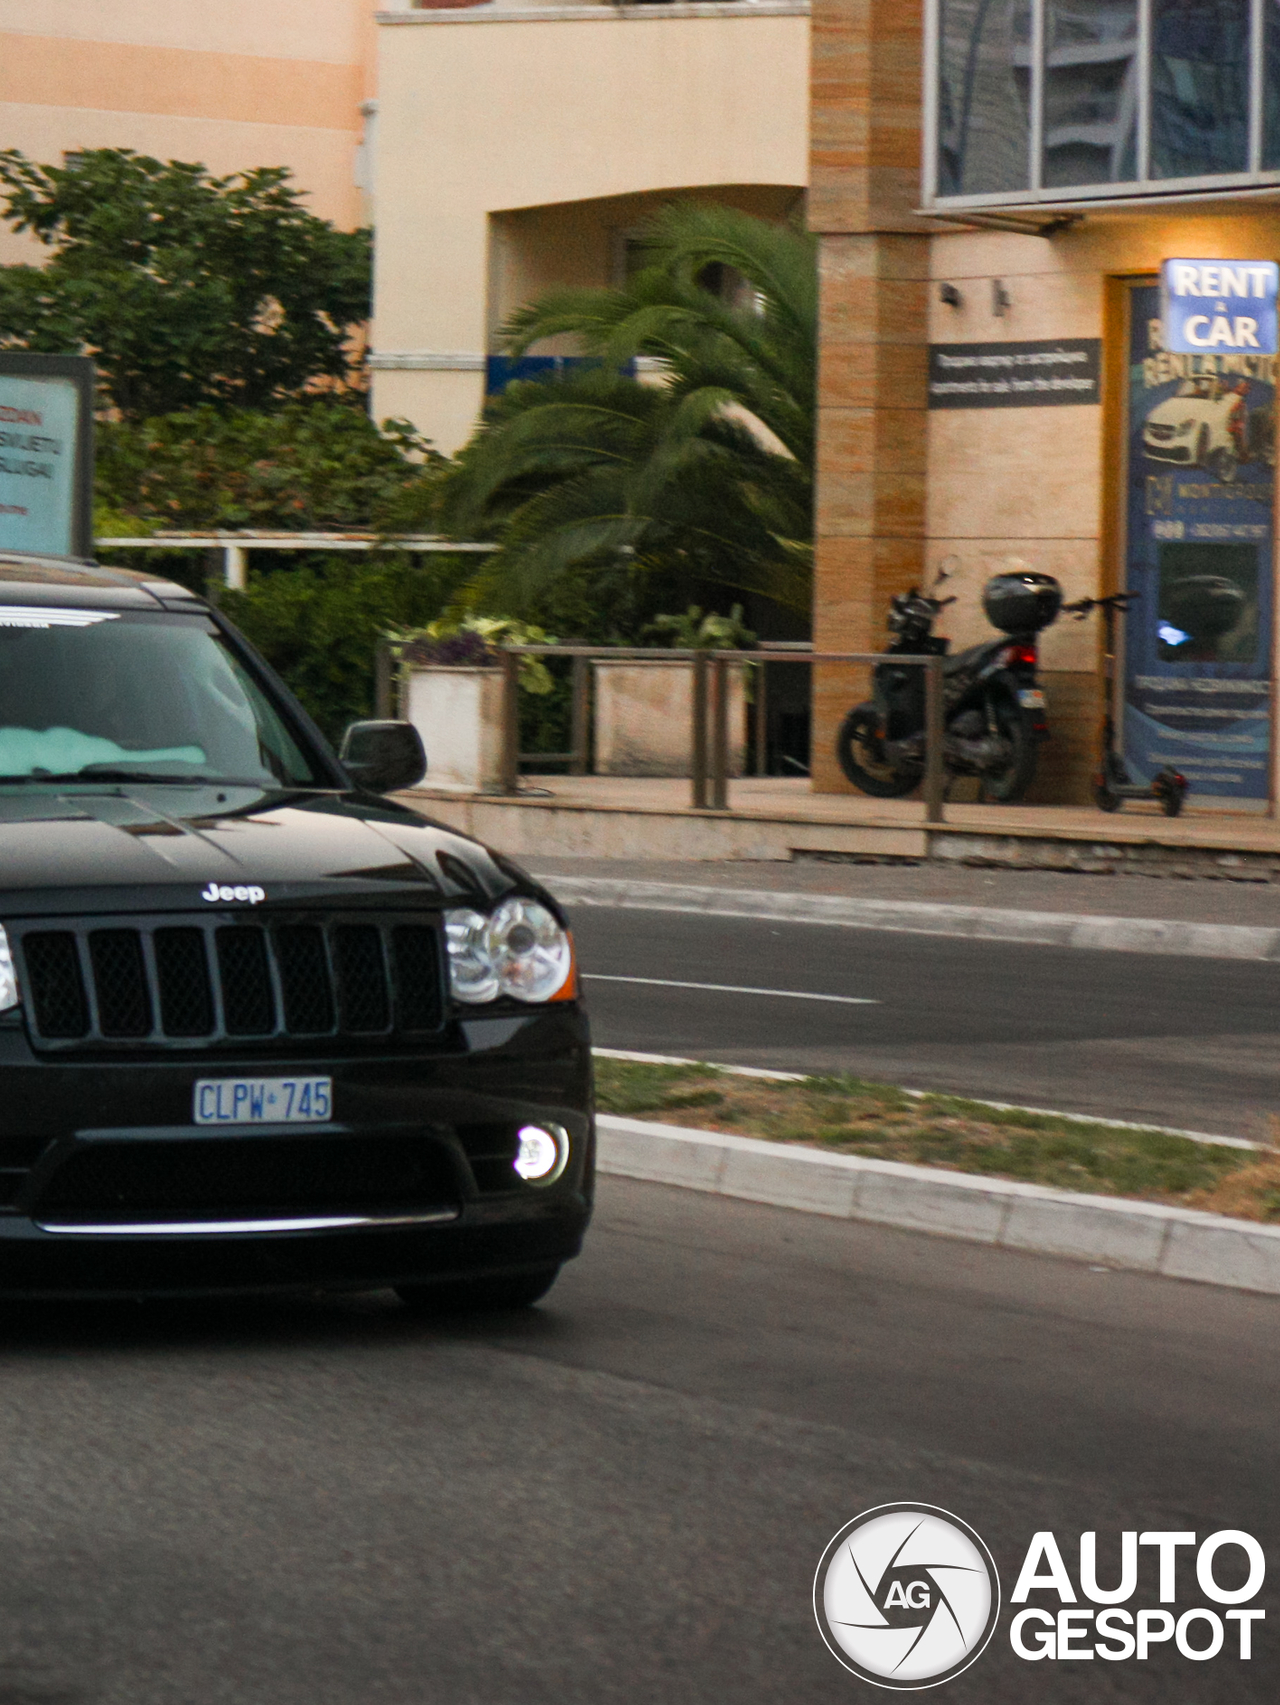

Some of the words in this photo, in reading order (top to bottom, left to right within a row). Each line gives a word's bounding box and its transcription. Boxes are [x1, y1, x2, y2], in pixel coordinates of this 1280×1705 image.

[1174, 265, 1274, 299] RENT
[1184, 315, 1261, 348] CAR
[202, 882, 266, 905] Jeep
[199, 1083, 265, 1119] CLPW
[282, 1081, 329, 1117] 745
